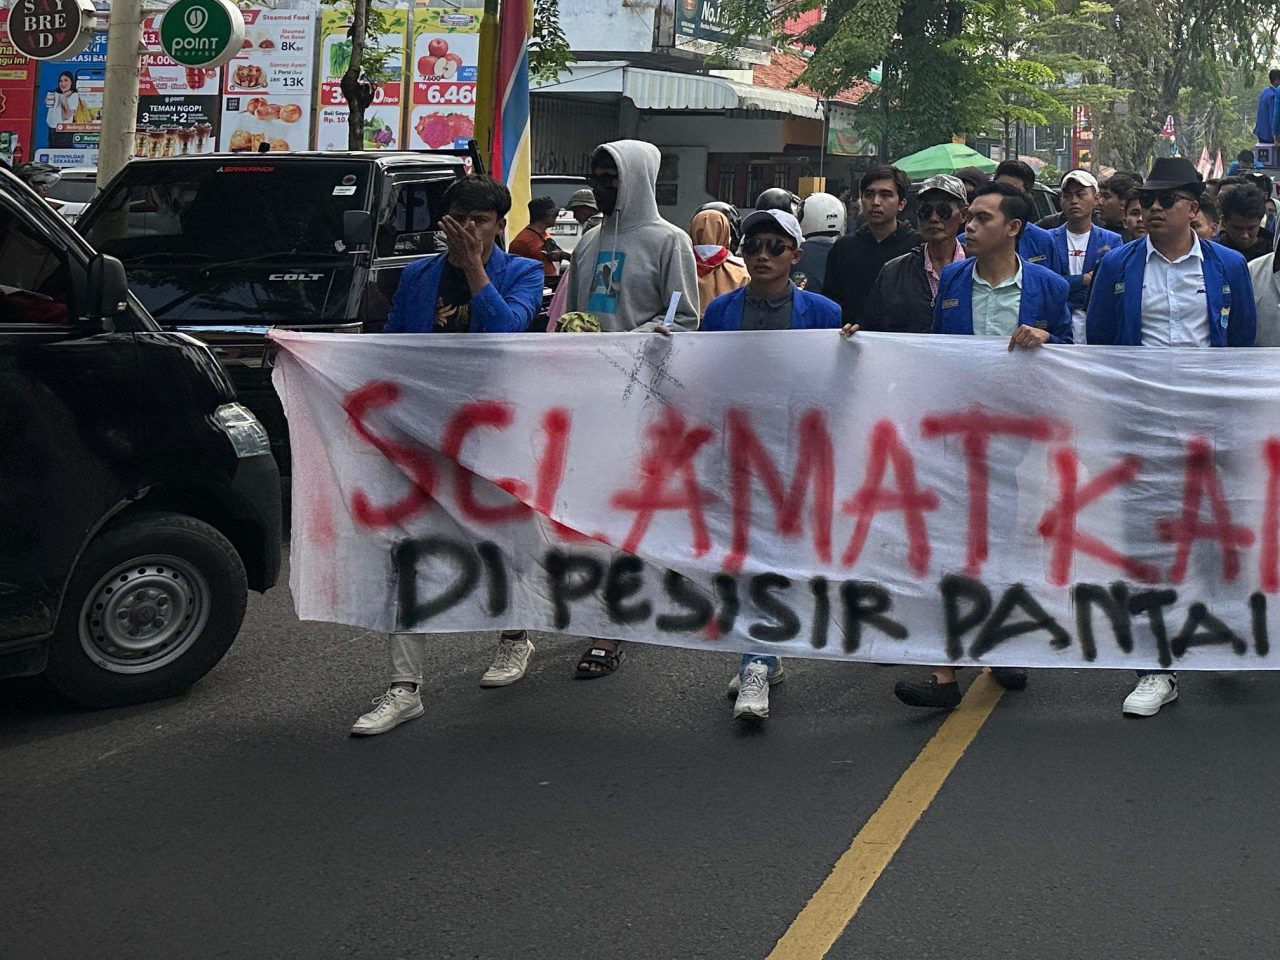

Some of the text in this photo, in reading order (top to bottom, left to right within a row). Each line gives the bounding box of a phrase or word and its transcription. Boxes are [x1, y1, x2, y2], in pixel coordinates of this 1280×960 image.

[24, 13, 67, 32] BRE
[282, 77, 304, 87] 13K
[141, 112, 150, 123] 3
[268, 273, 325, 281] COLT
[389, 539, 509, 632] DI
[543, 548, 909, 655] PESISIR
[937, 571, 1270, 668] PANTAI
